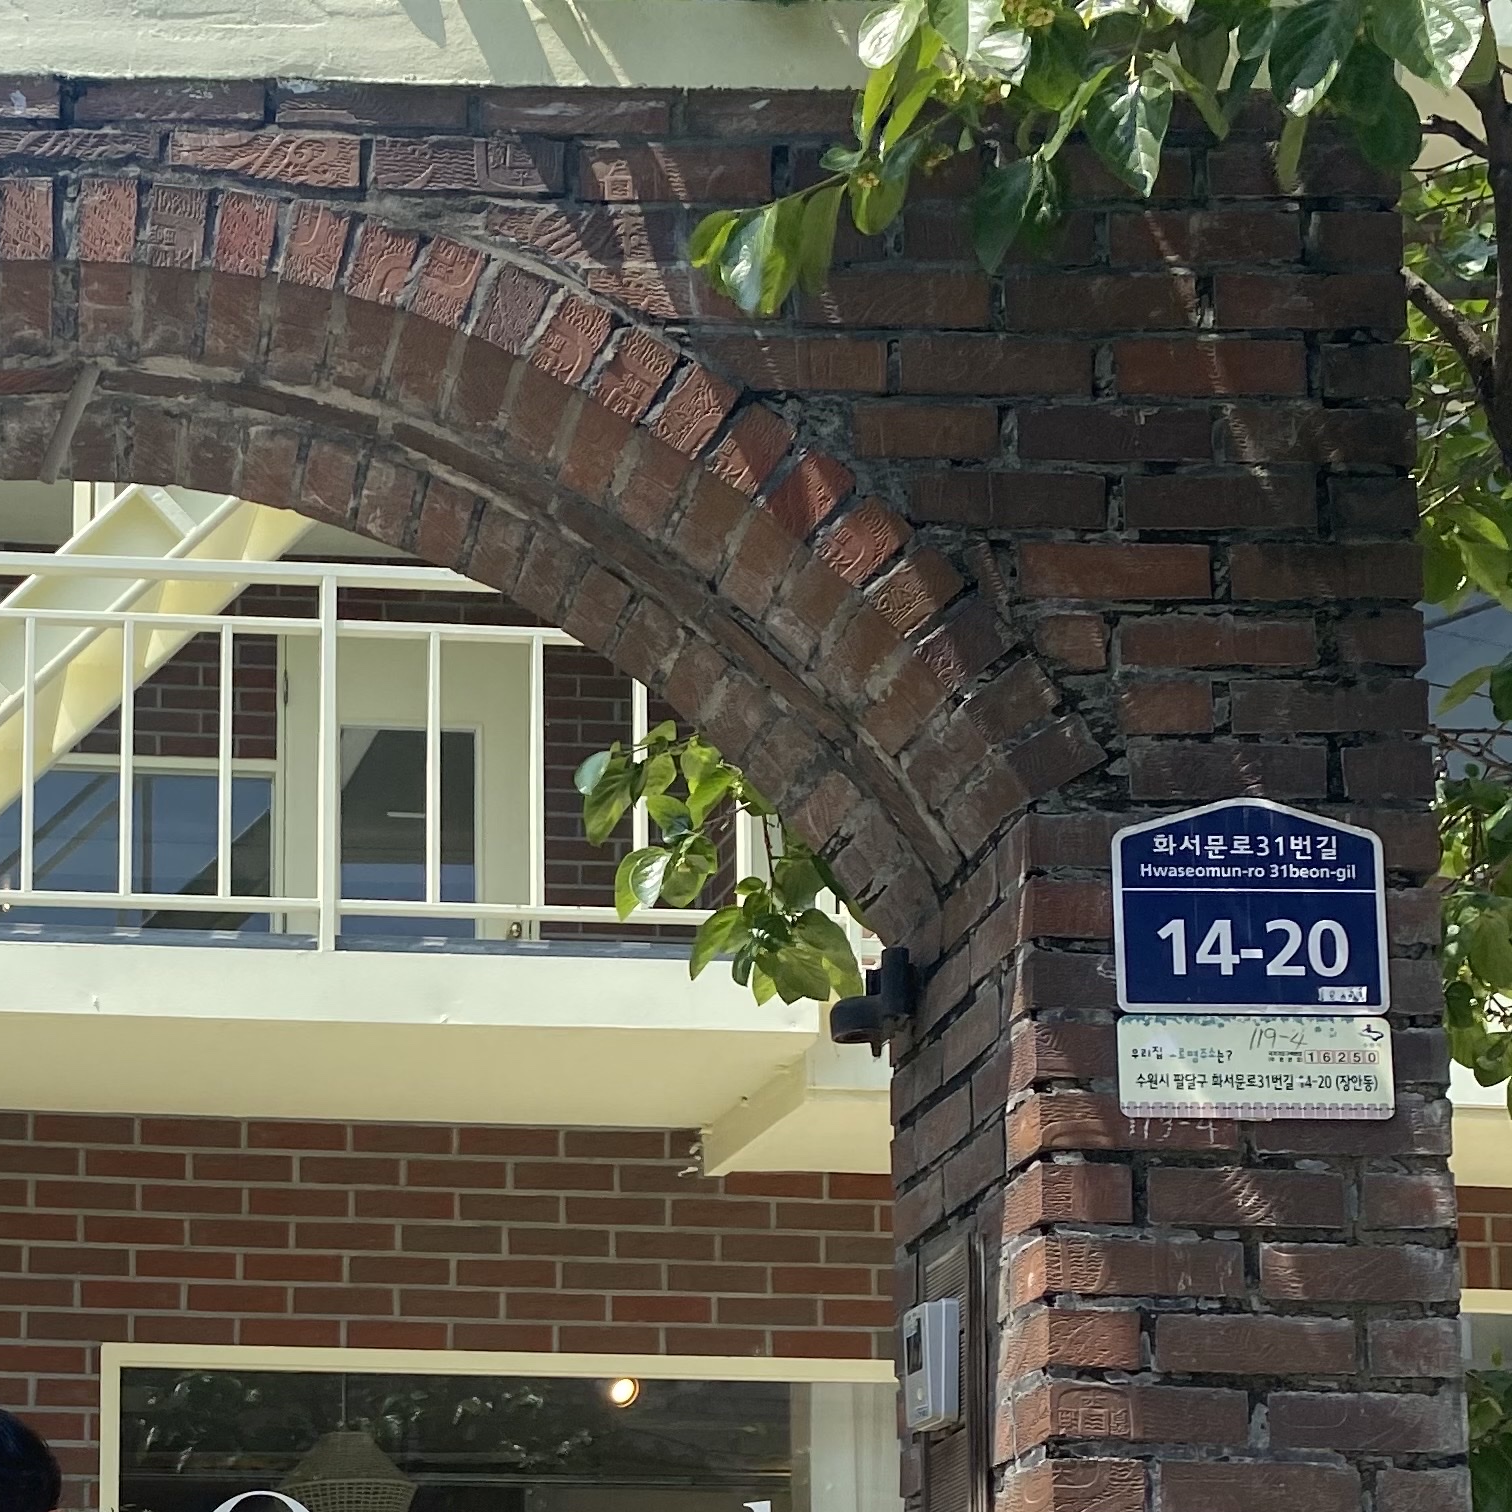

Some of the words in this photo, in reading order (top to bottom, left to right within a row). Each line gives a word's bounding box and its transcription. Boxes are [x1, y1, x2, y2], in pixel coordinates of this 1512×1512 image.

[1152, 833, 1338, 860] 화서문로31번길
[1140, 863, 1265, 878] Hwaseomun-ro
[1269, 864, 1357, 882] 31beon-gil
[1156, 918, 1349, 977] 14-20
[1249, 1027, 1308, 1051] 119-4
[1131, 1046, 1163, 1060] 우리집
[1307, 1051, 1377, 1063] 16250
[1136, 1073, 1170, 1090] 수원시
[1173, 1073, 1208, 1091] 팔달구
[1211, 1073, 1294, 1091] 화서문로31번길
[1335, 1074, 1379, 1092] (장안동)
